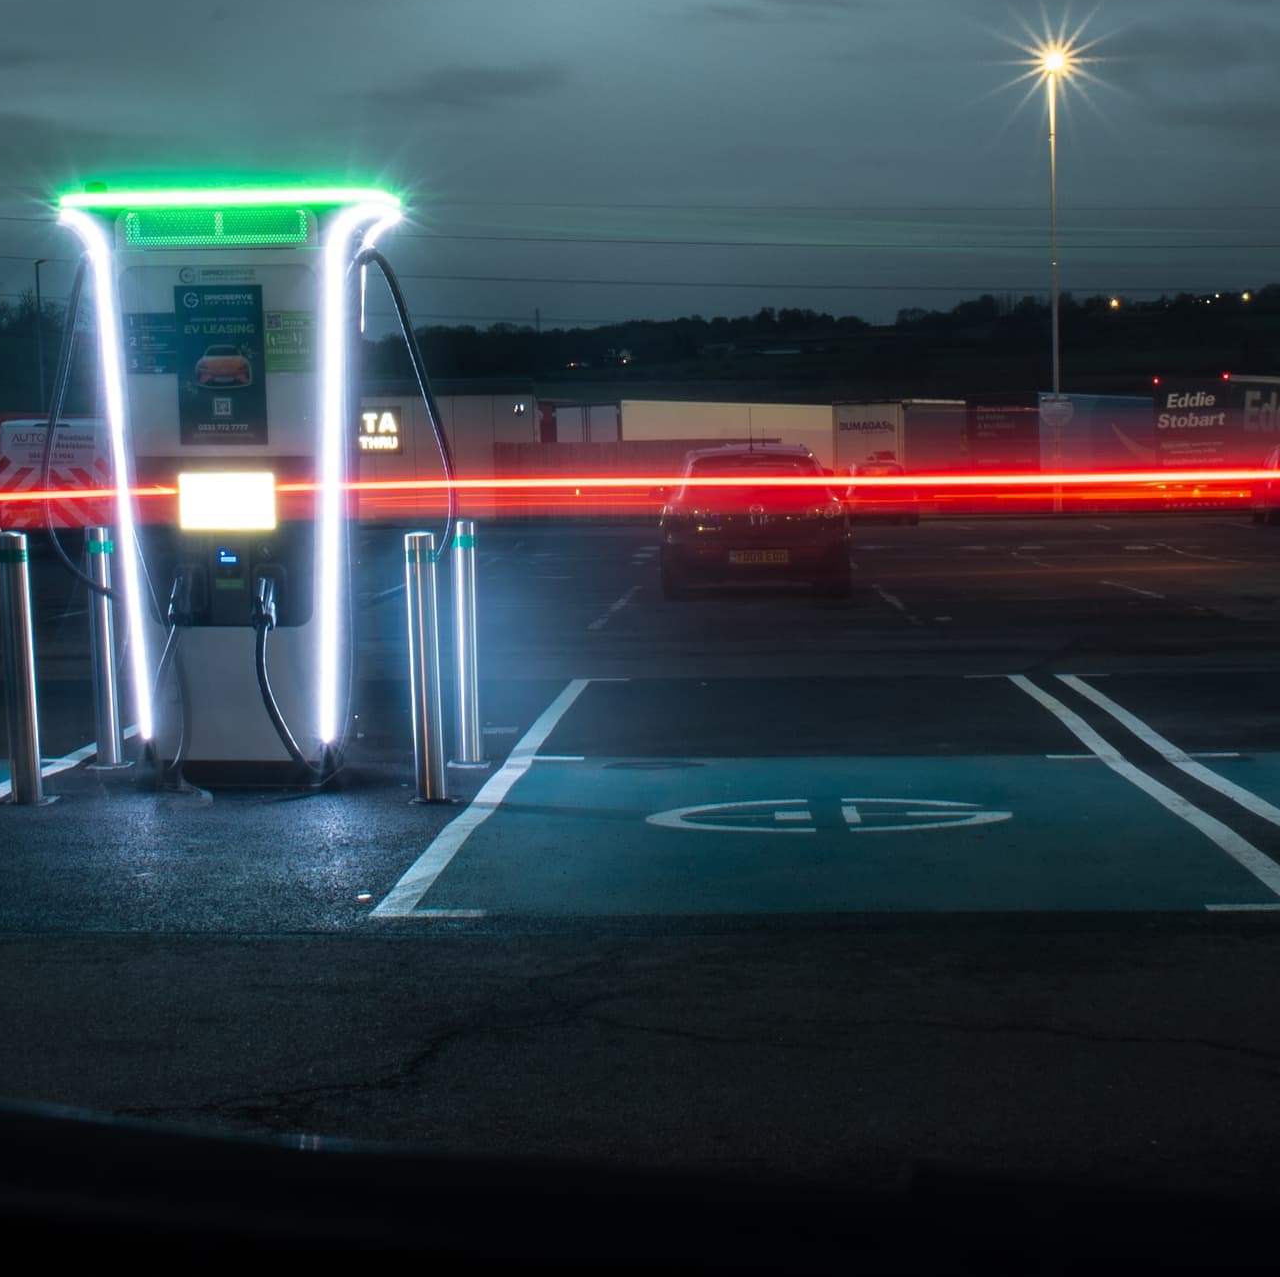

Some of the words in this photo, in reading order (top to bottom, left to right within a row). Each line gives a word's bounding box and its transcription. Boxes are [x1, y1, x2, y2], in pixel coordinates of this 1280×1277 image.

[184, 324, 201, 334] EV
[203, 323, 256, 335] LEASING
[1167, 391, 1216, 409] Eddie
[360, 412, 398, 434] TA
[1157, 411, 1226, 429] Stobart
